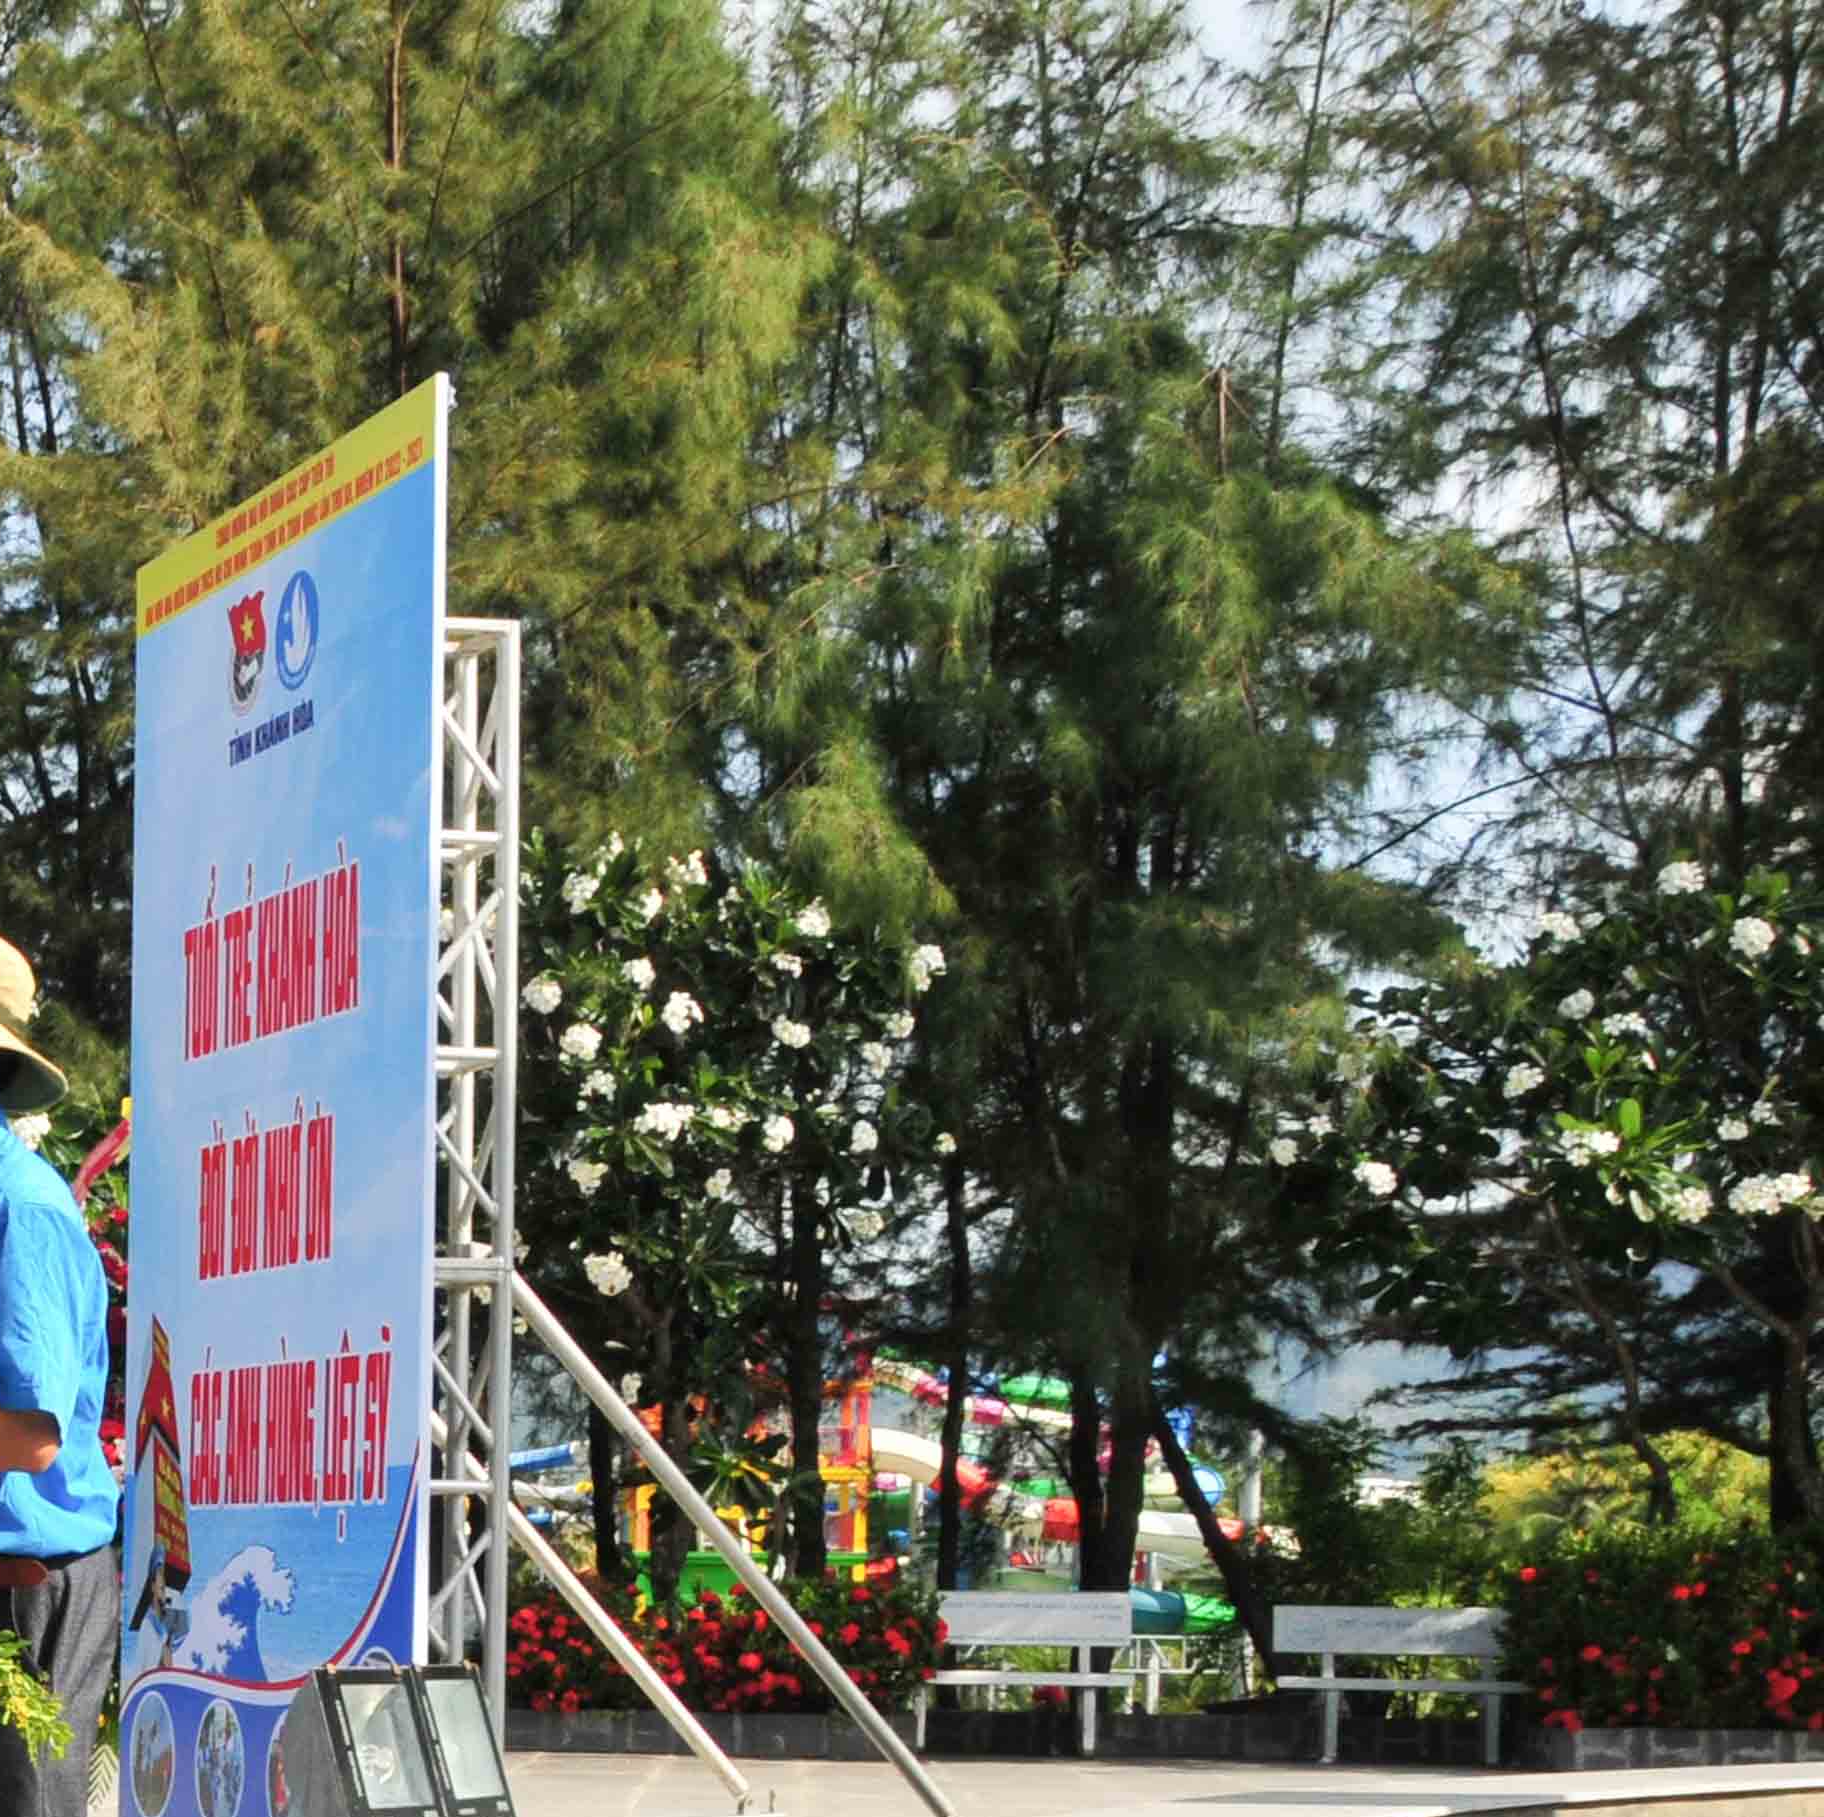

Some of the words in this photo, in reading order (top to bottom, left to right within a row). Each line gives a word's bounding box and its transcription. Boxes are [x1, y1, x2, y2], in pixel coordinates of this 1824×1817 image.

[184, 864, 219, 1061] TUỔI
[224, 864, 252, 1046] TRẺ
[256, 861, 318, 1039] KHÁNH
[322, 842, 359, 1017] HÒA
[198, 1120, 227, 1281] ĐỜI
[230, 1109, 259, 1274] ĐỜI
[264, 1095, 303, 1270] NHỚ
[305, 1102, 335, 1263] ƠN
[189, 1347, 222, 1506] CÁC
[224, 1362, 262, 1504] ANH
[322, 1329, 360, 1544] LIỆT
